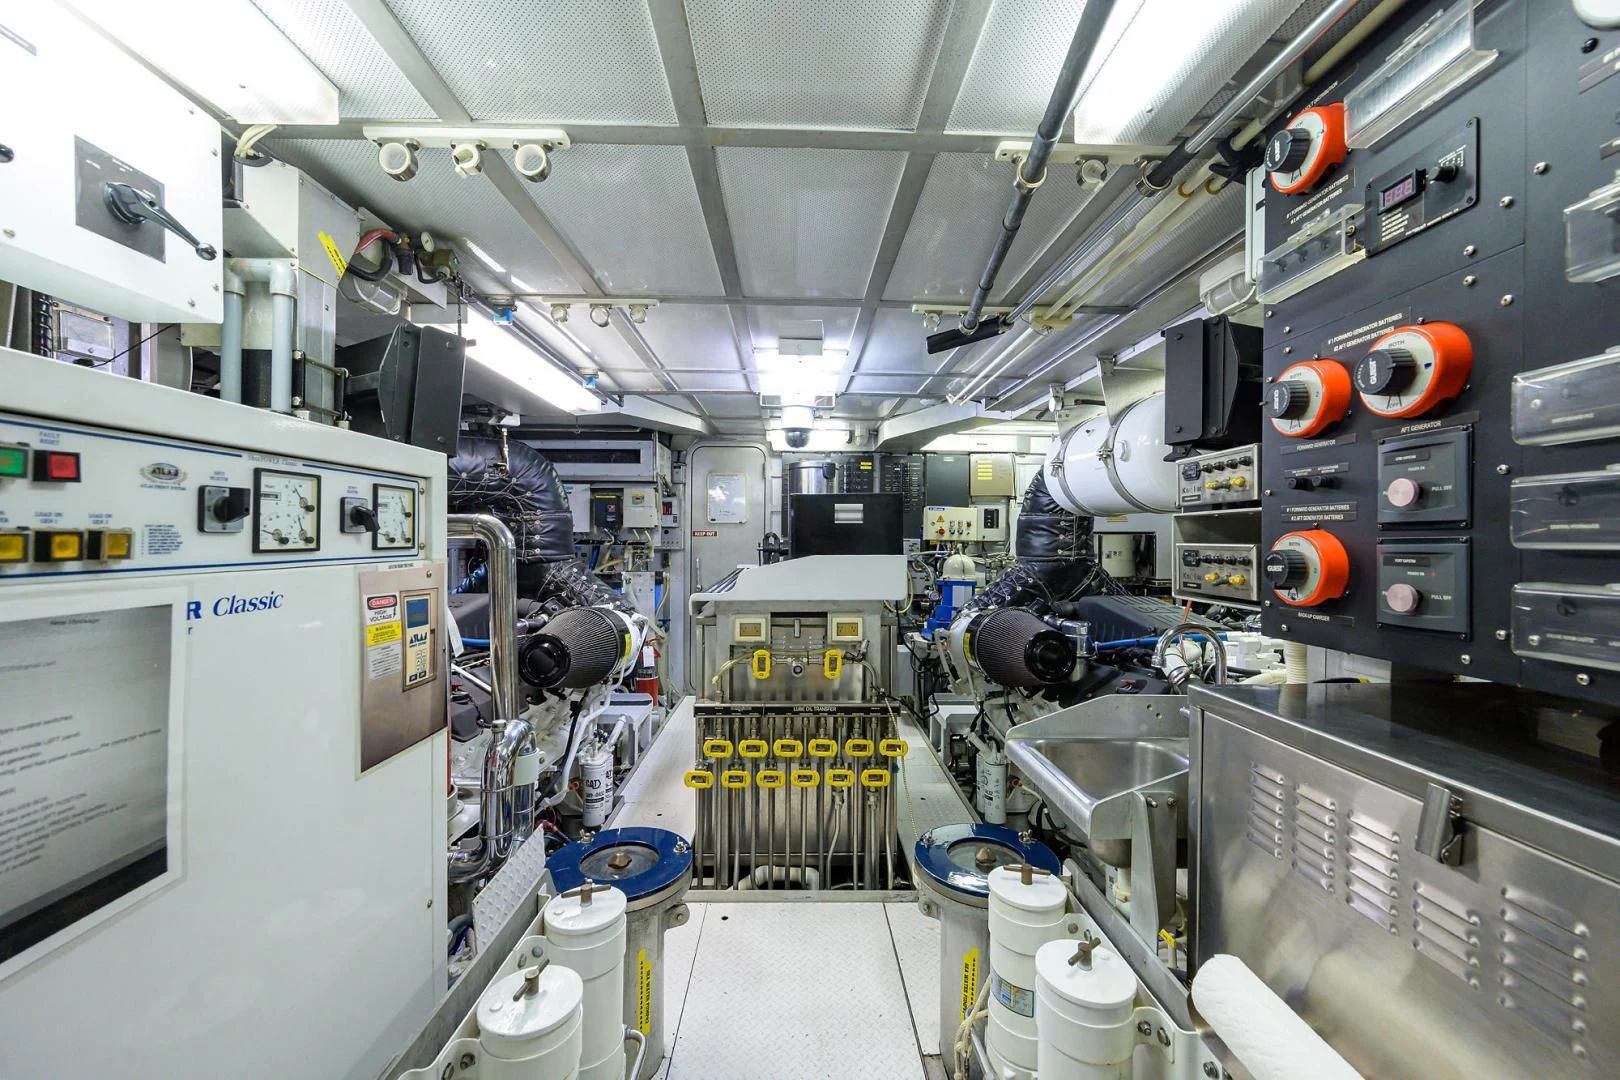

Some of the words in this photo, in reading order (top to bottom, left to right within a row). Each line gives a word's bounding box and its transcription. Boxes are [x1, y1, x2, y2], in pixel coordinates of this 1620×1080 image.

[1378, 312, 1402, 327] BATTERIES
[1346, 334, 1370, 348] GENERATOR
[1370, 325, 1394, 340] BATTERIES
[1400, 425, 1411, 433] AFT
[1411, 421, 1442, 432] GENERATOR
[213, 590, 284, 617] Classic
[372, 598, 394, 606] DANGER
[369, 614, 392, 622] VOLTAGE
